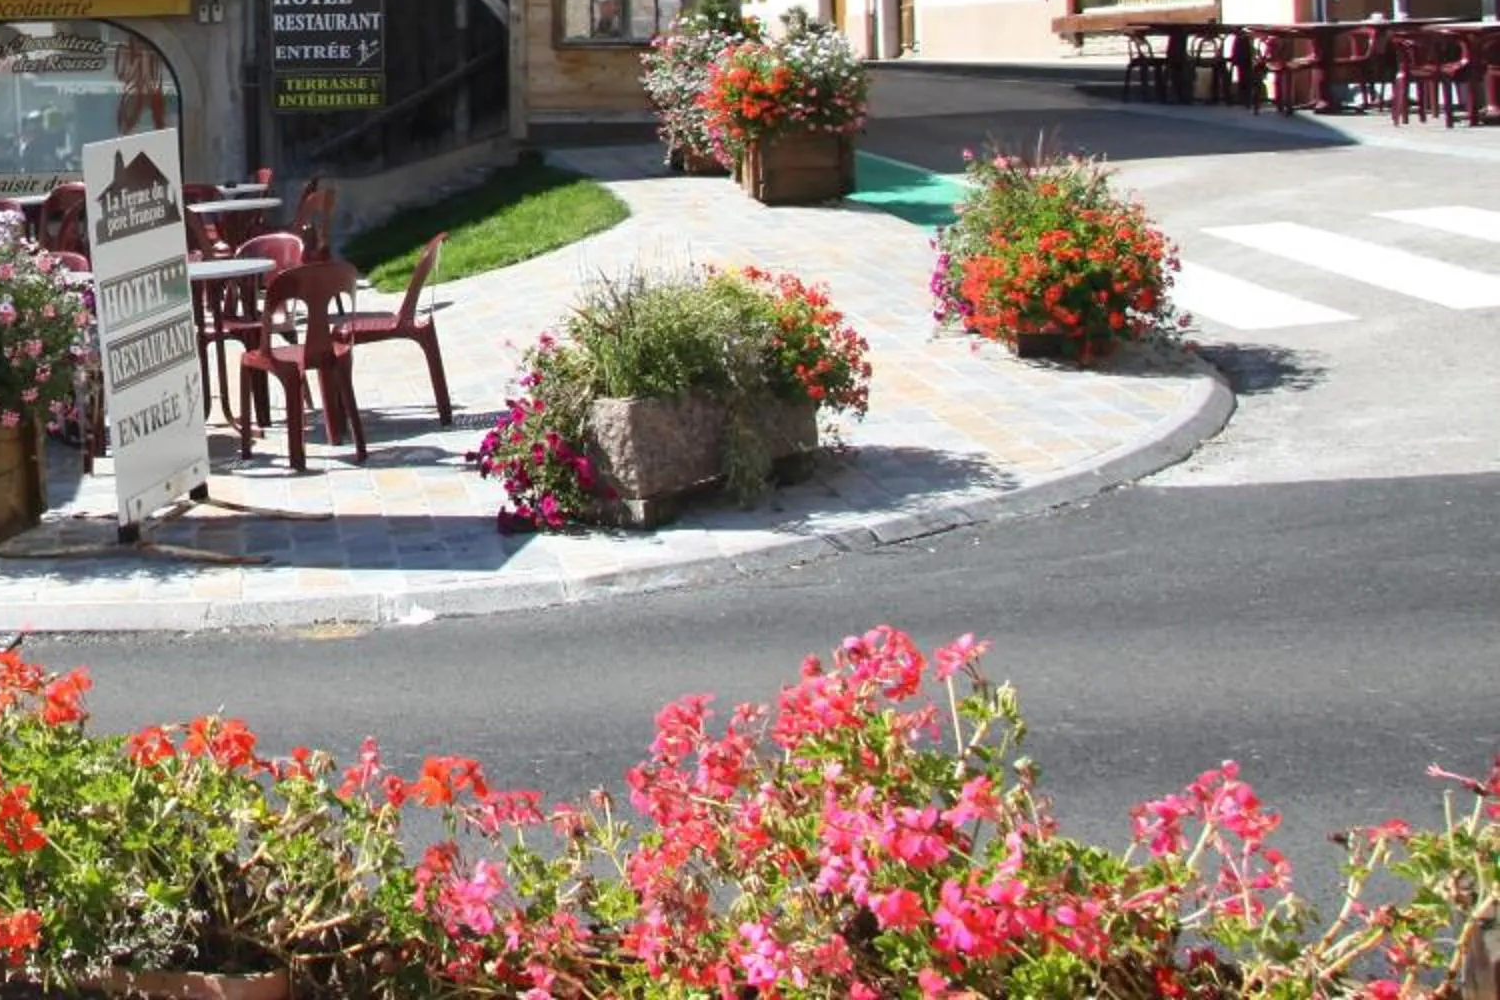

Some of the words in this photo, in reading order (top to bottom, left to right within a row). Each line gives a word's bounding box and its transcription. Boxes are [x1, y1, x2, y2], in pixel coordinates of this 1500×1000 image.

[273, 11, 381, 31] RESTAURANT
[275, 41, 352, 60] ENTRÉE
[286, 77, 369, 91] TERRASSE
[278, 90, 381, 107] INTÉRIEURE
[106, 191, 119, 212] La
[120, 187, 151, 209] Ferme
[103, 270, 168, 322] HOTEL
[109, 320, 197, 385] RESTAURANT
[117, 391, 181, 449] ENTRÉE
